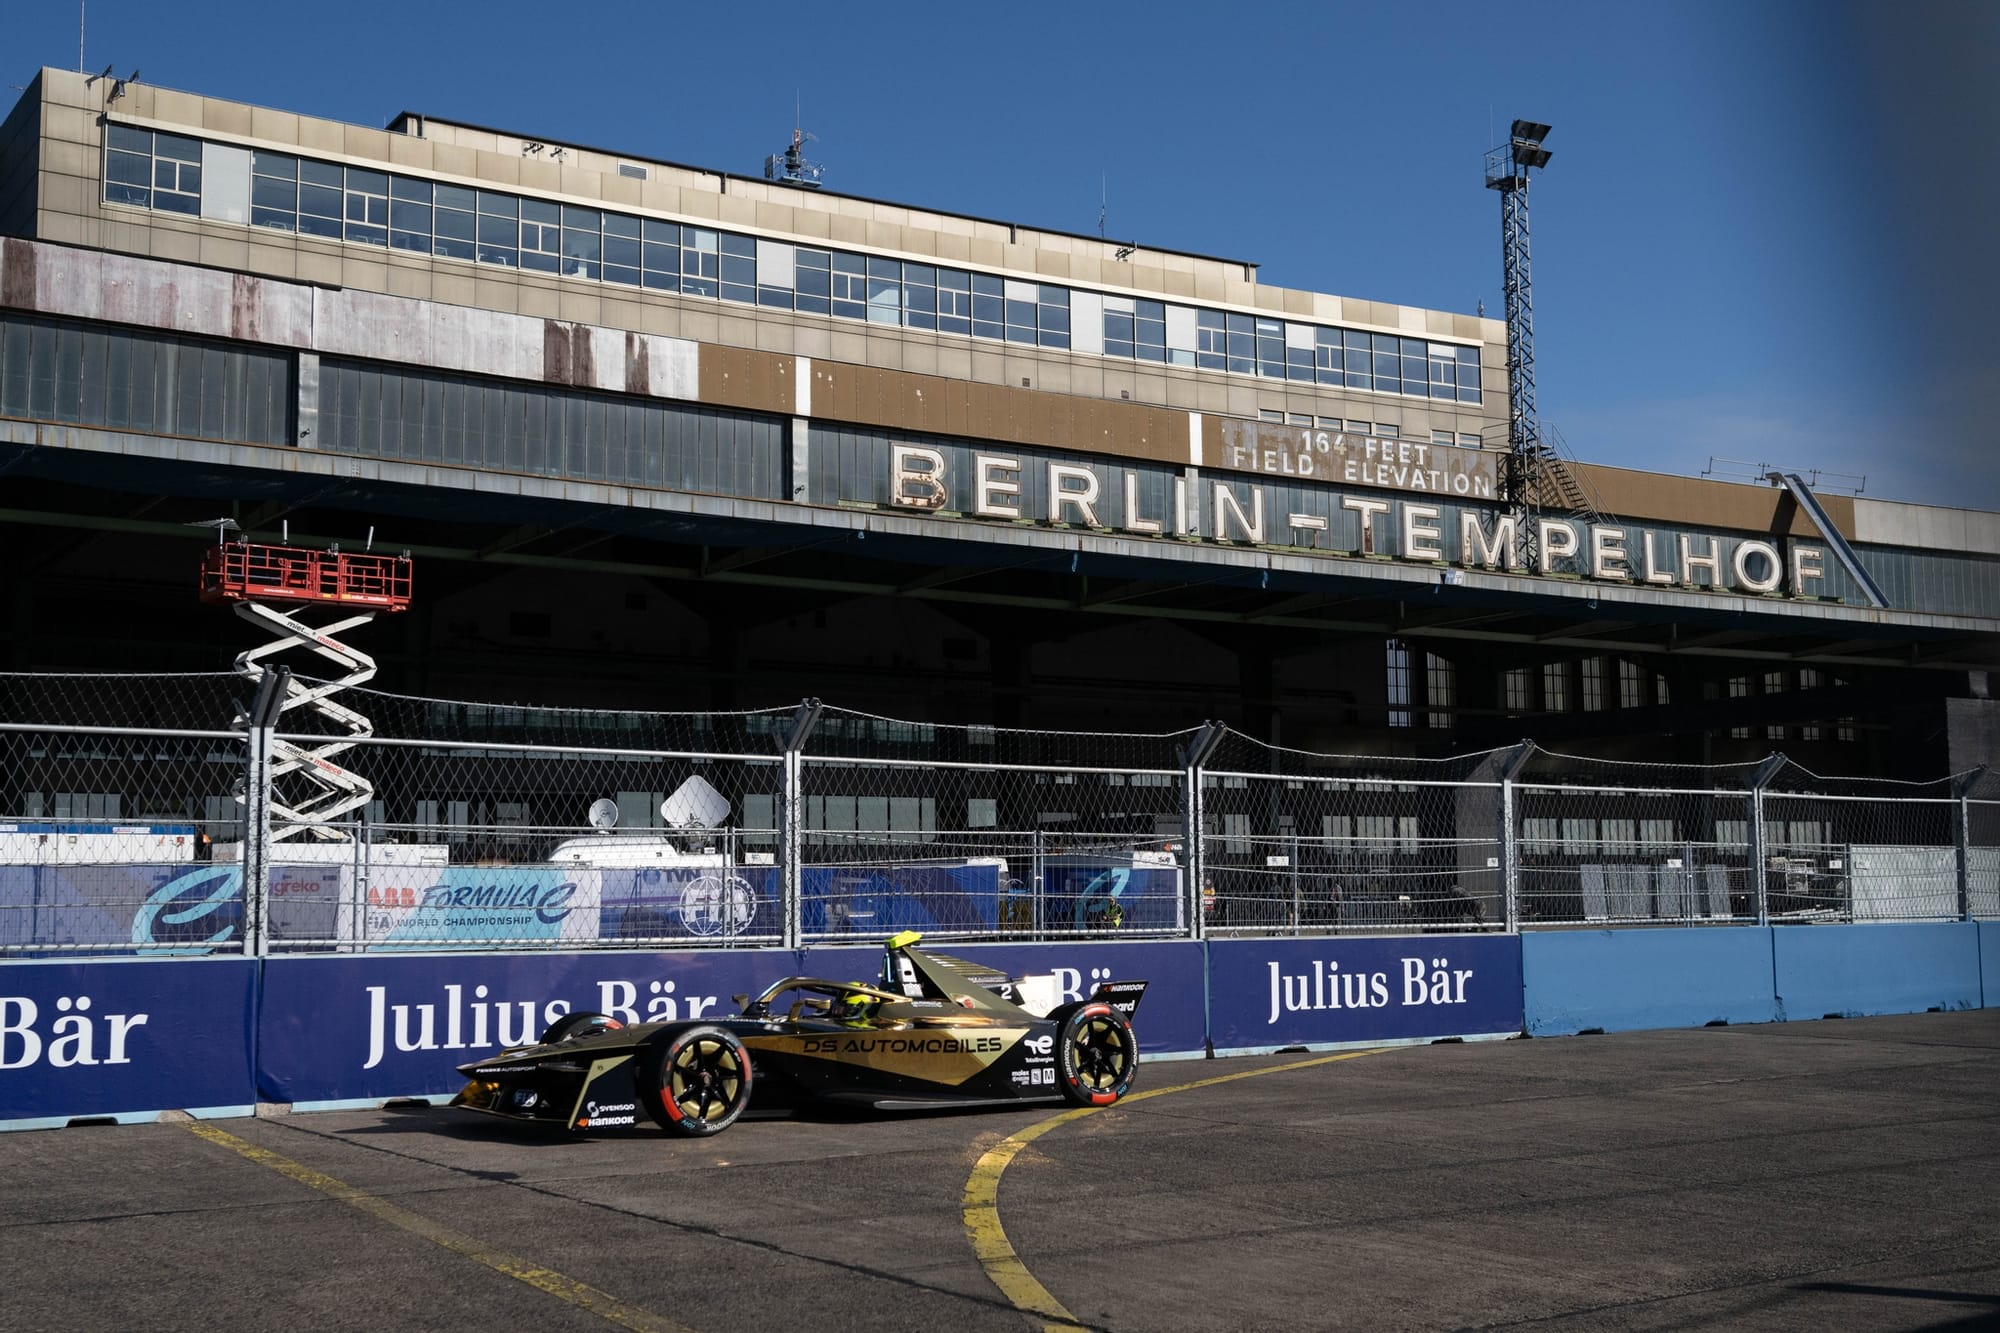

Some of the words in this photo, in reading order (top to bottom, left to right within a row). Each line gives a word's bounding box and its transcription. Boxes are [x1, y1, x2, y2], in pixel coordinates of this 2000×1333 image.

[1301, 430, 1347, 455] 164
[1365, 439, 1428, 465] FEET
[1233, 446, 1314, 475] FIELD
[1345, 460, 1489, 497] ELEVATION
[316, 635, 345, 652] mateco
[368, 886, 415, 909] ABB
[419, 884, 539, 911] FORMULA
[396, 917, 439, 927] WORLD
[444, 916, 532, 926] CHAMPIONSHIP
[1267, 959, 1388, 1024] Julius
[1401, 957, 1472, 1006] Bär
[804, 1040, 838, 1053] DS
[844, 1037, 1002, 1053] AUTOMOBILES
